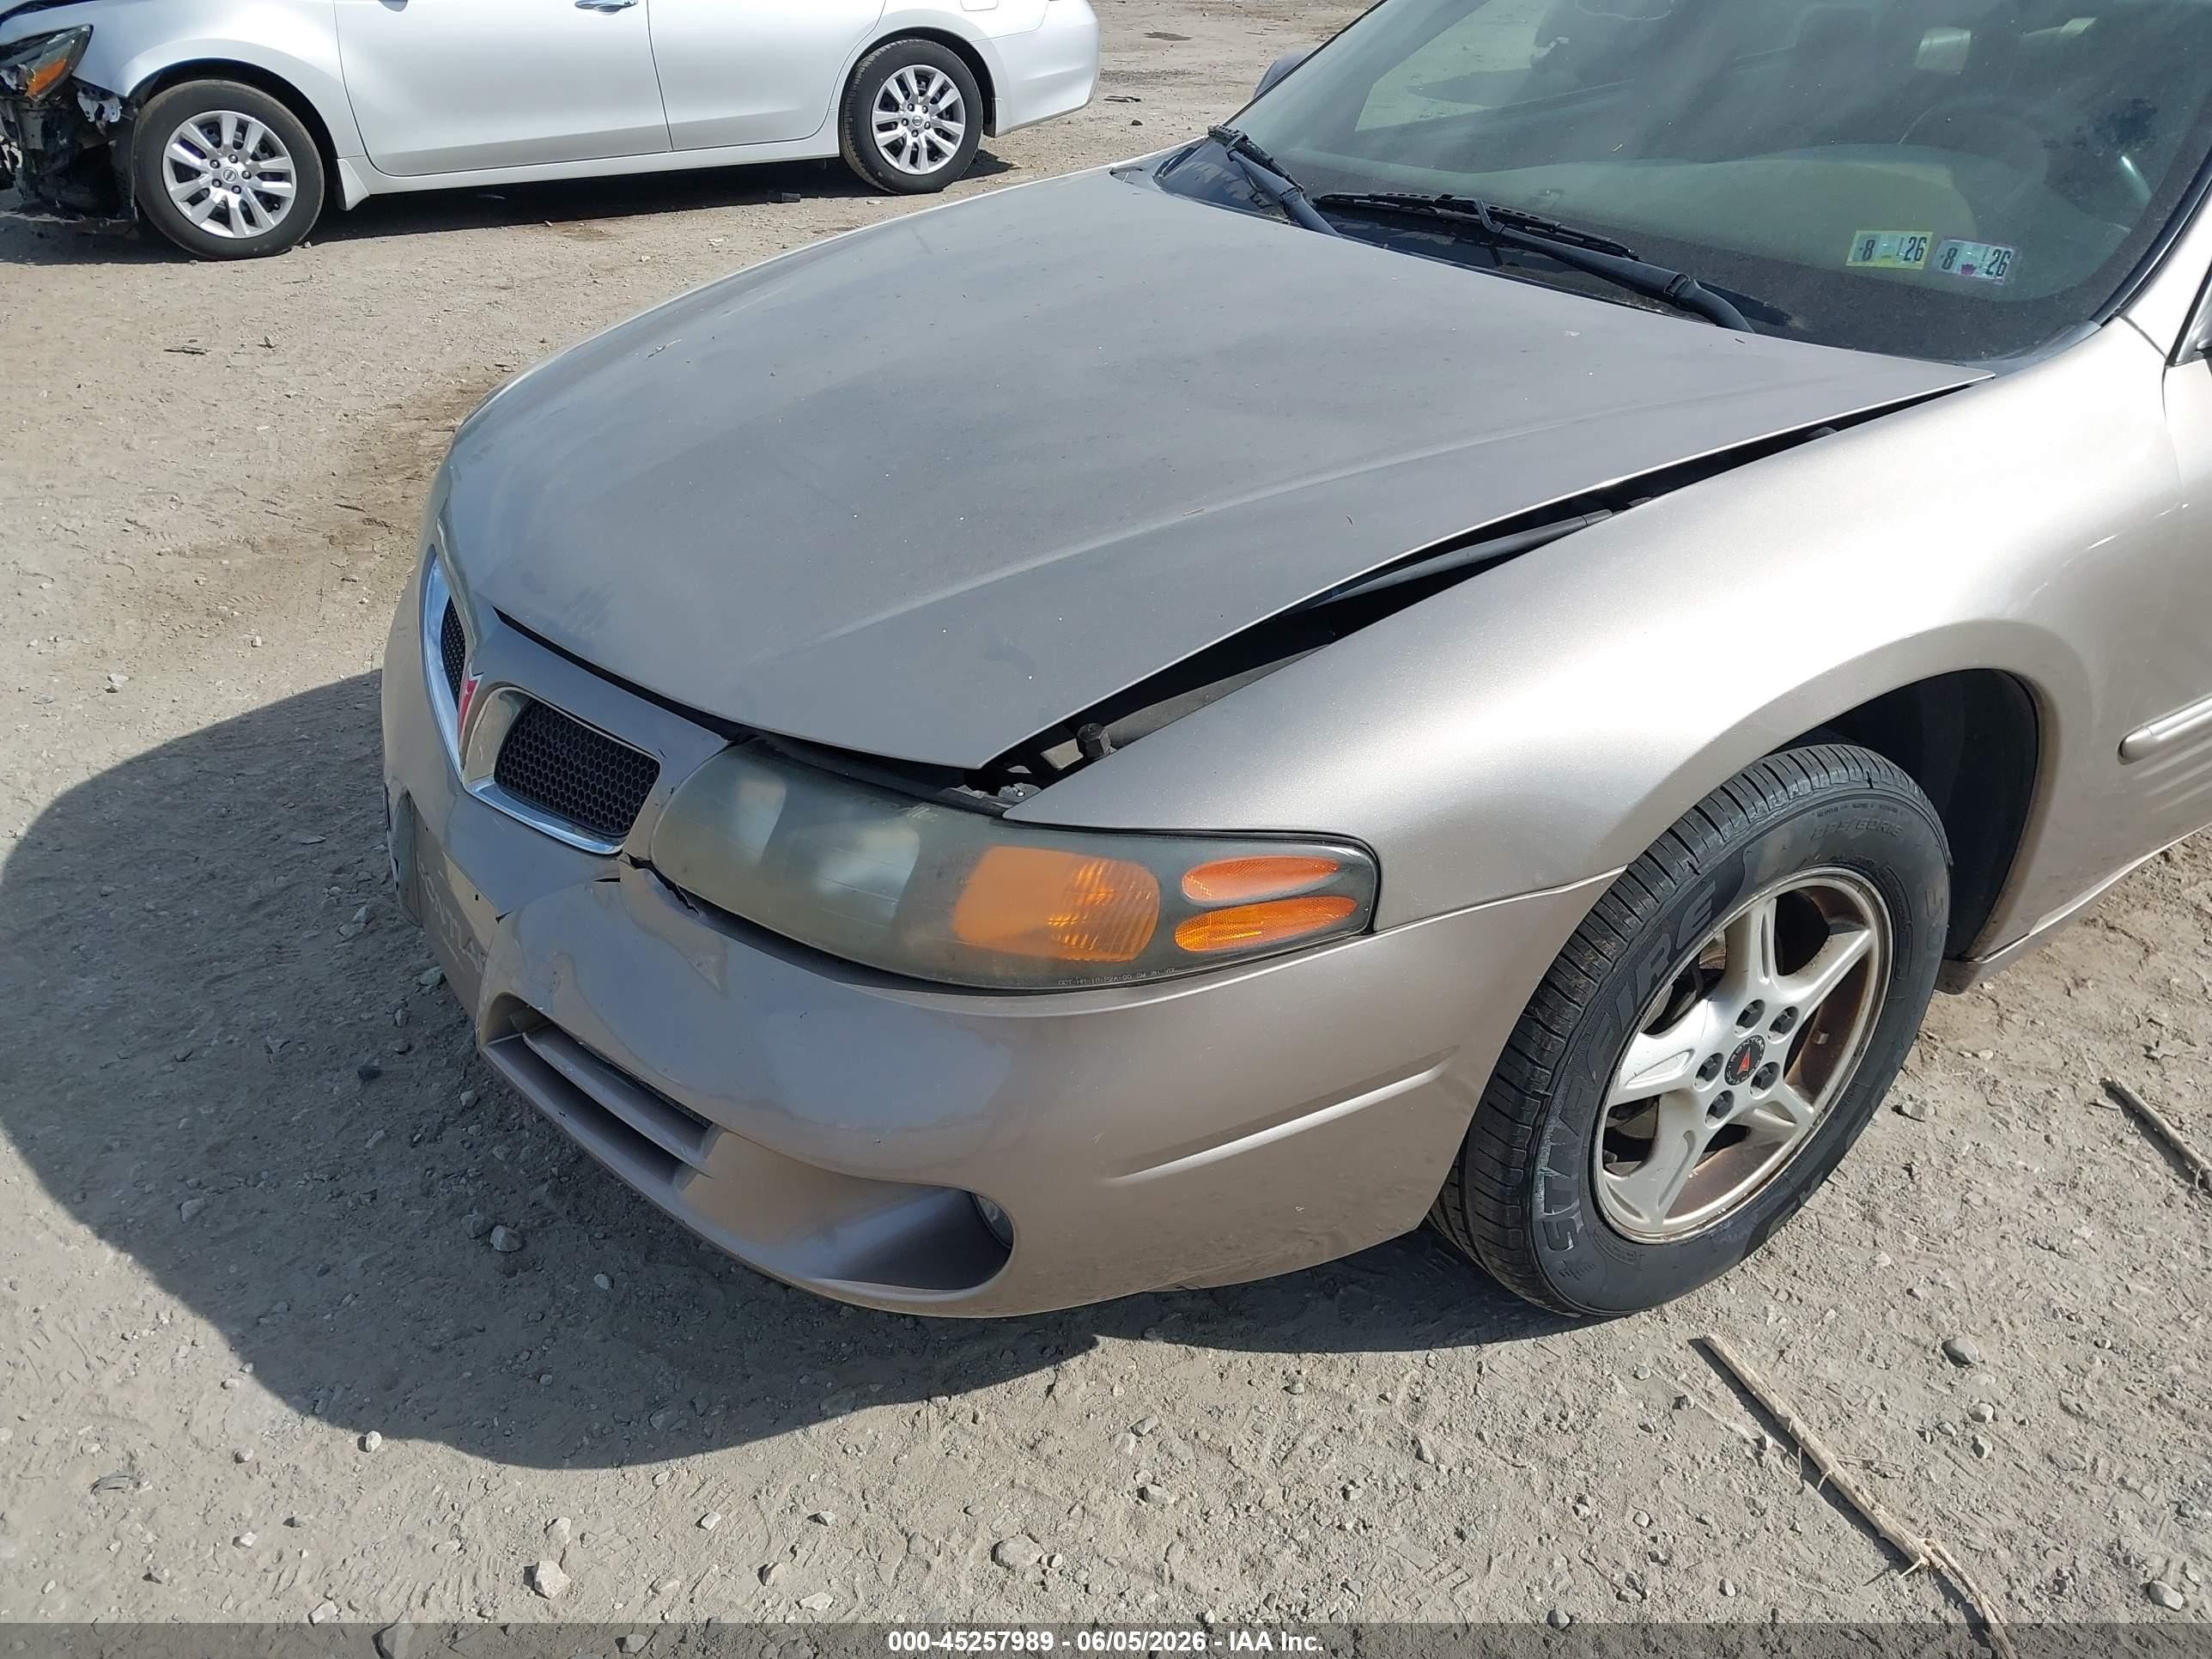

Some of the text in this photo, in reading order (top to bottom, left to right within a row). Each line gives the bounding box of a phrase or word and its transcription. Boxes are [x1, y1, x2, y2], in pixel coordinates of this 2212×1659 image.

[1862, 240, 1875, 261] 8
[1904, 236, 1927, 262] 26
[1941, 247, 1959, 270] 8
[1984, 248, 2012, 277] 26
[1730, 1036, 1764, 1062] PONTIAC
